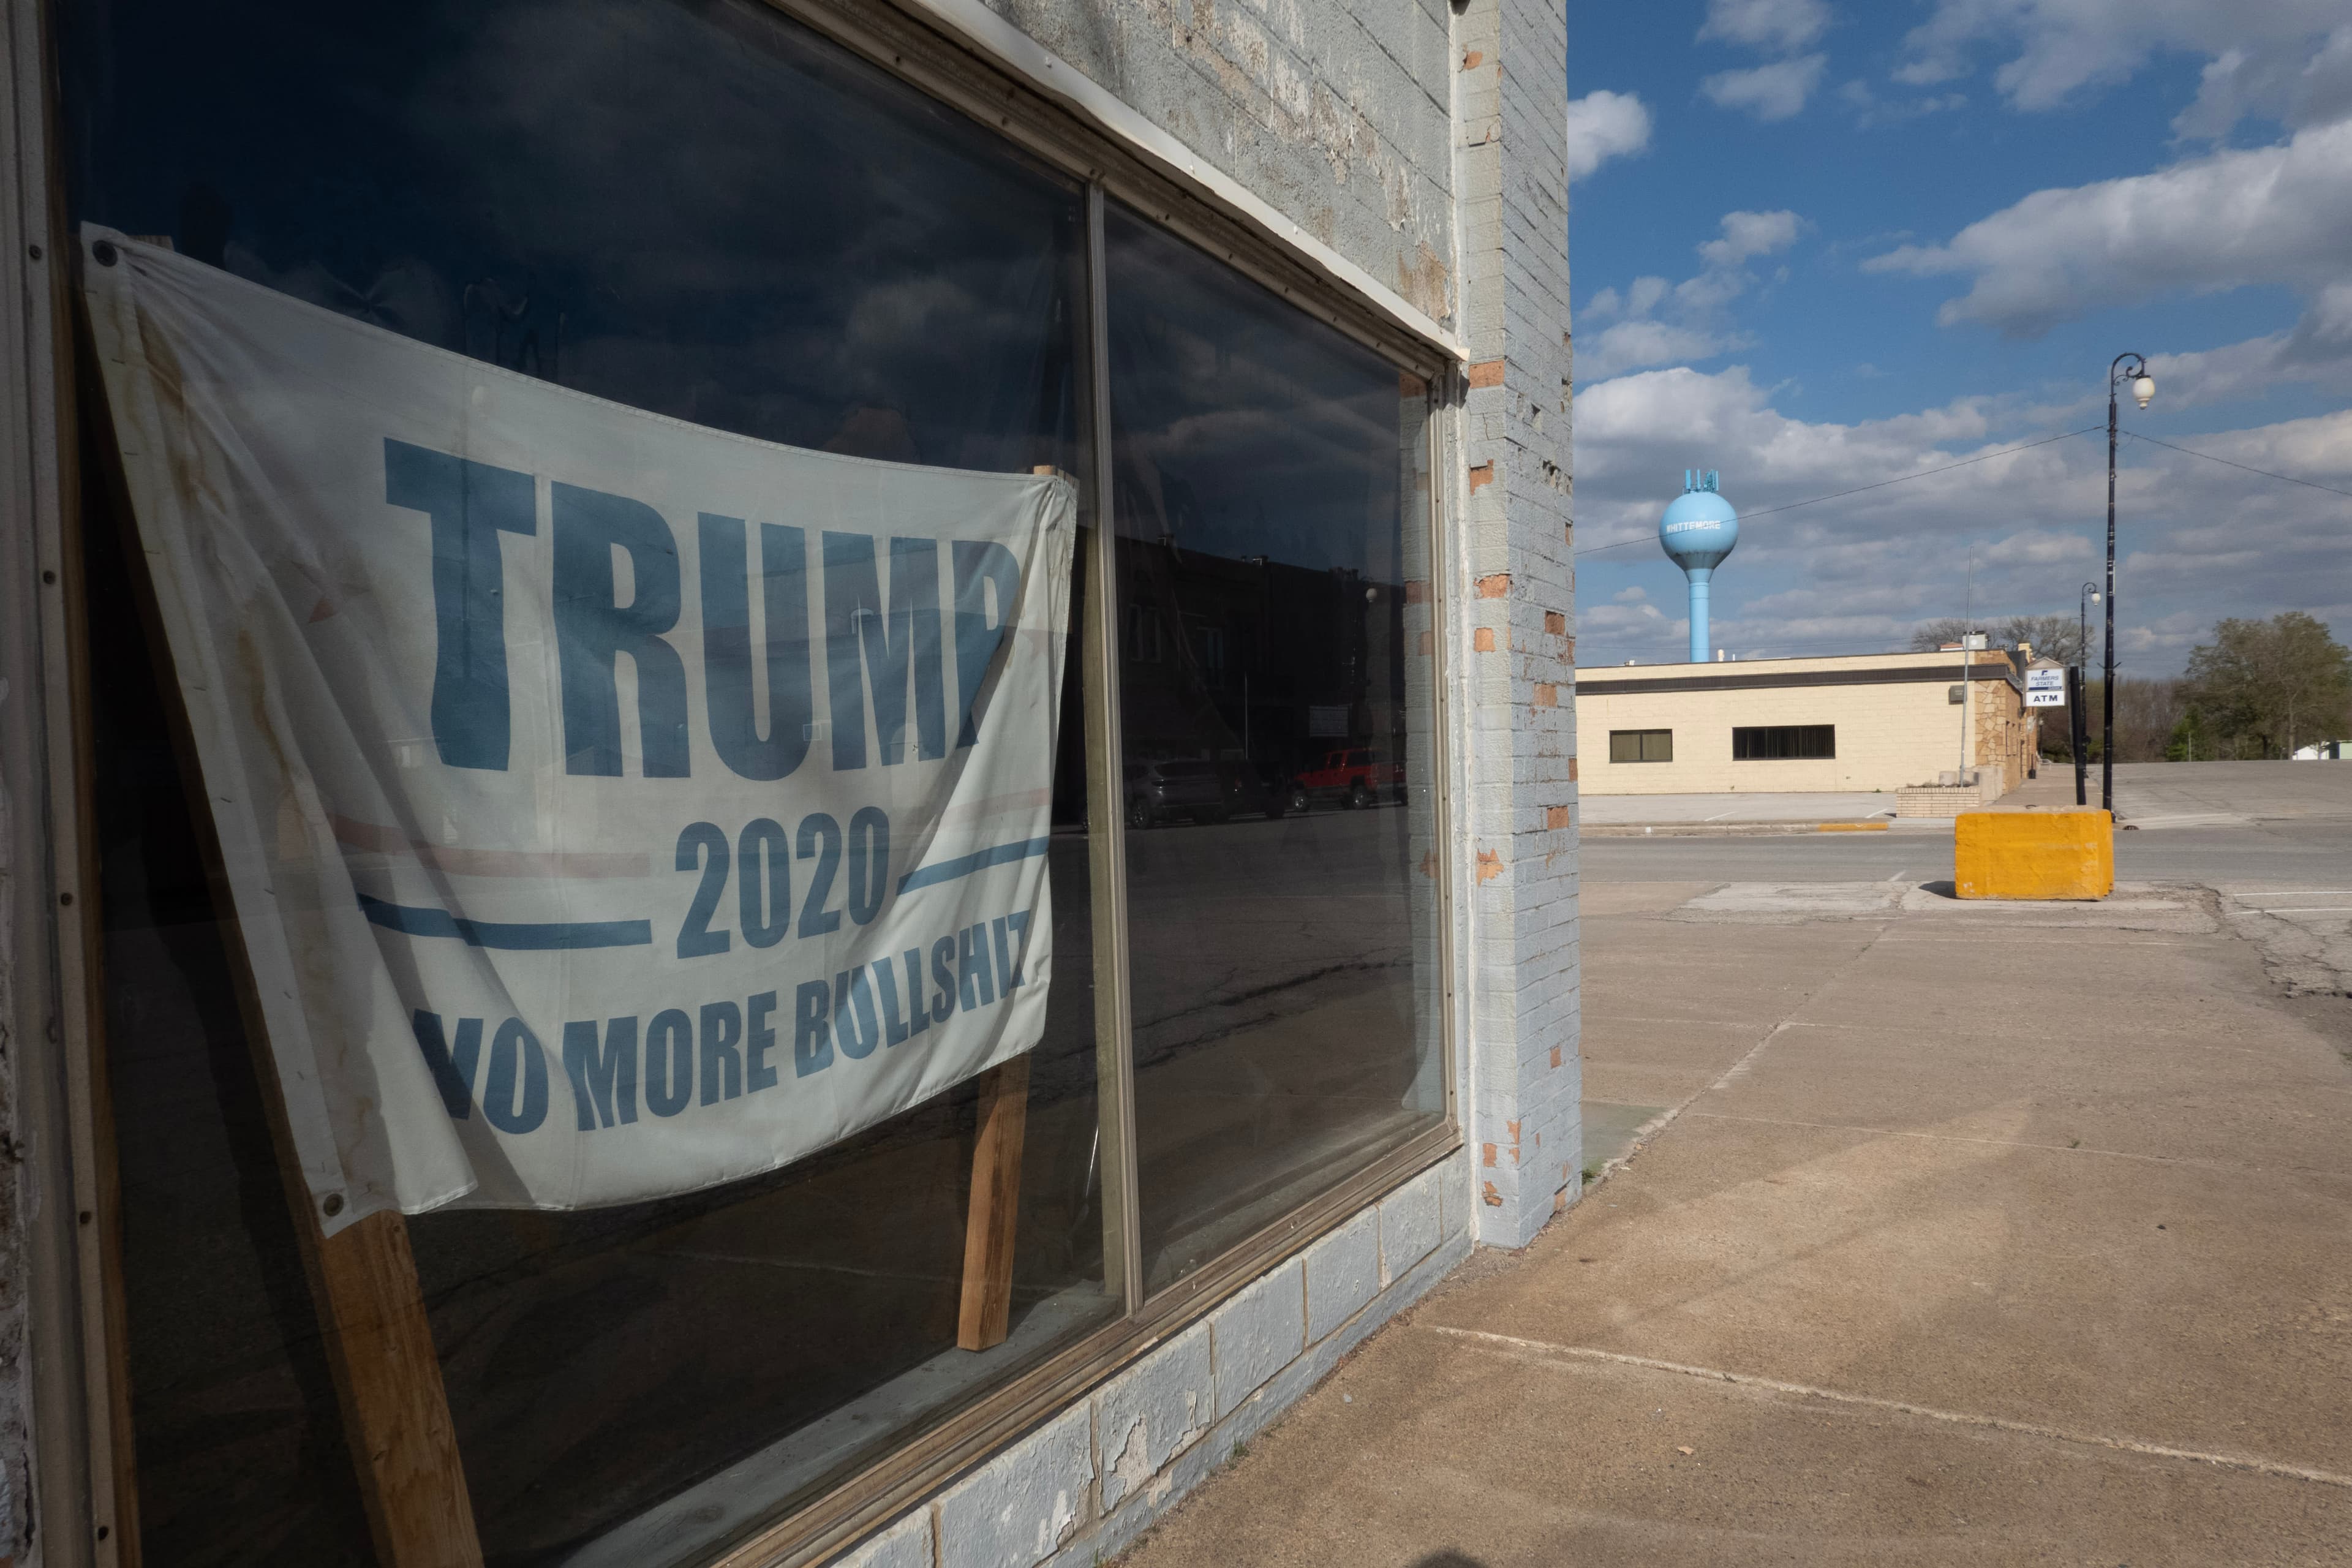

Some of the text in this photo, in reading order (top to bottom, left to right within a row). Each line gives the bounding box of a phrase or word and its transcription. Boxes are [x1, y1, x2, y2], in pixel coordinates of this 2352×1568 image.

[383, 437, 1020, 781] TRUMP
[1666, 521, 1721, 533] WHITTEMORE
[675, 806, 891, 959] 2020
[562, 989, 778, 1131] MORE
[794, 910, 1031, 1079] BULLSHIT
